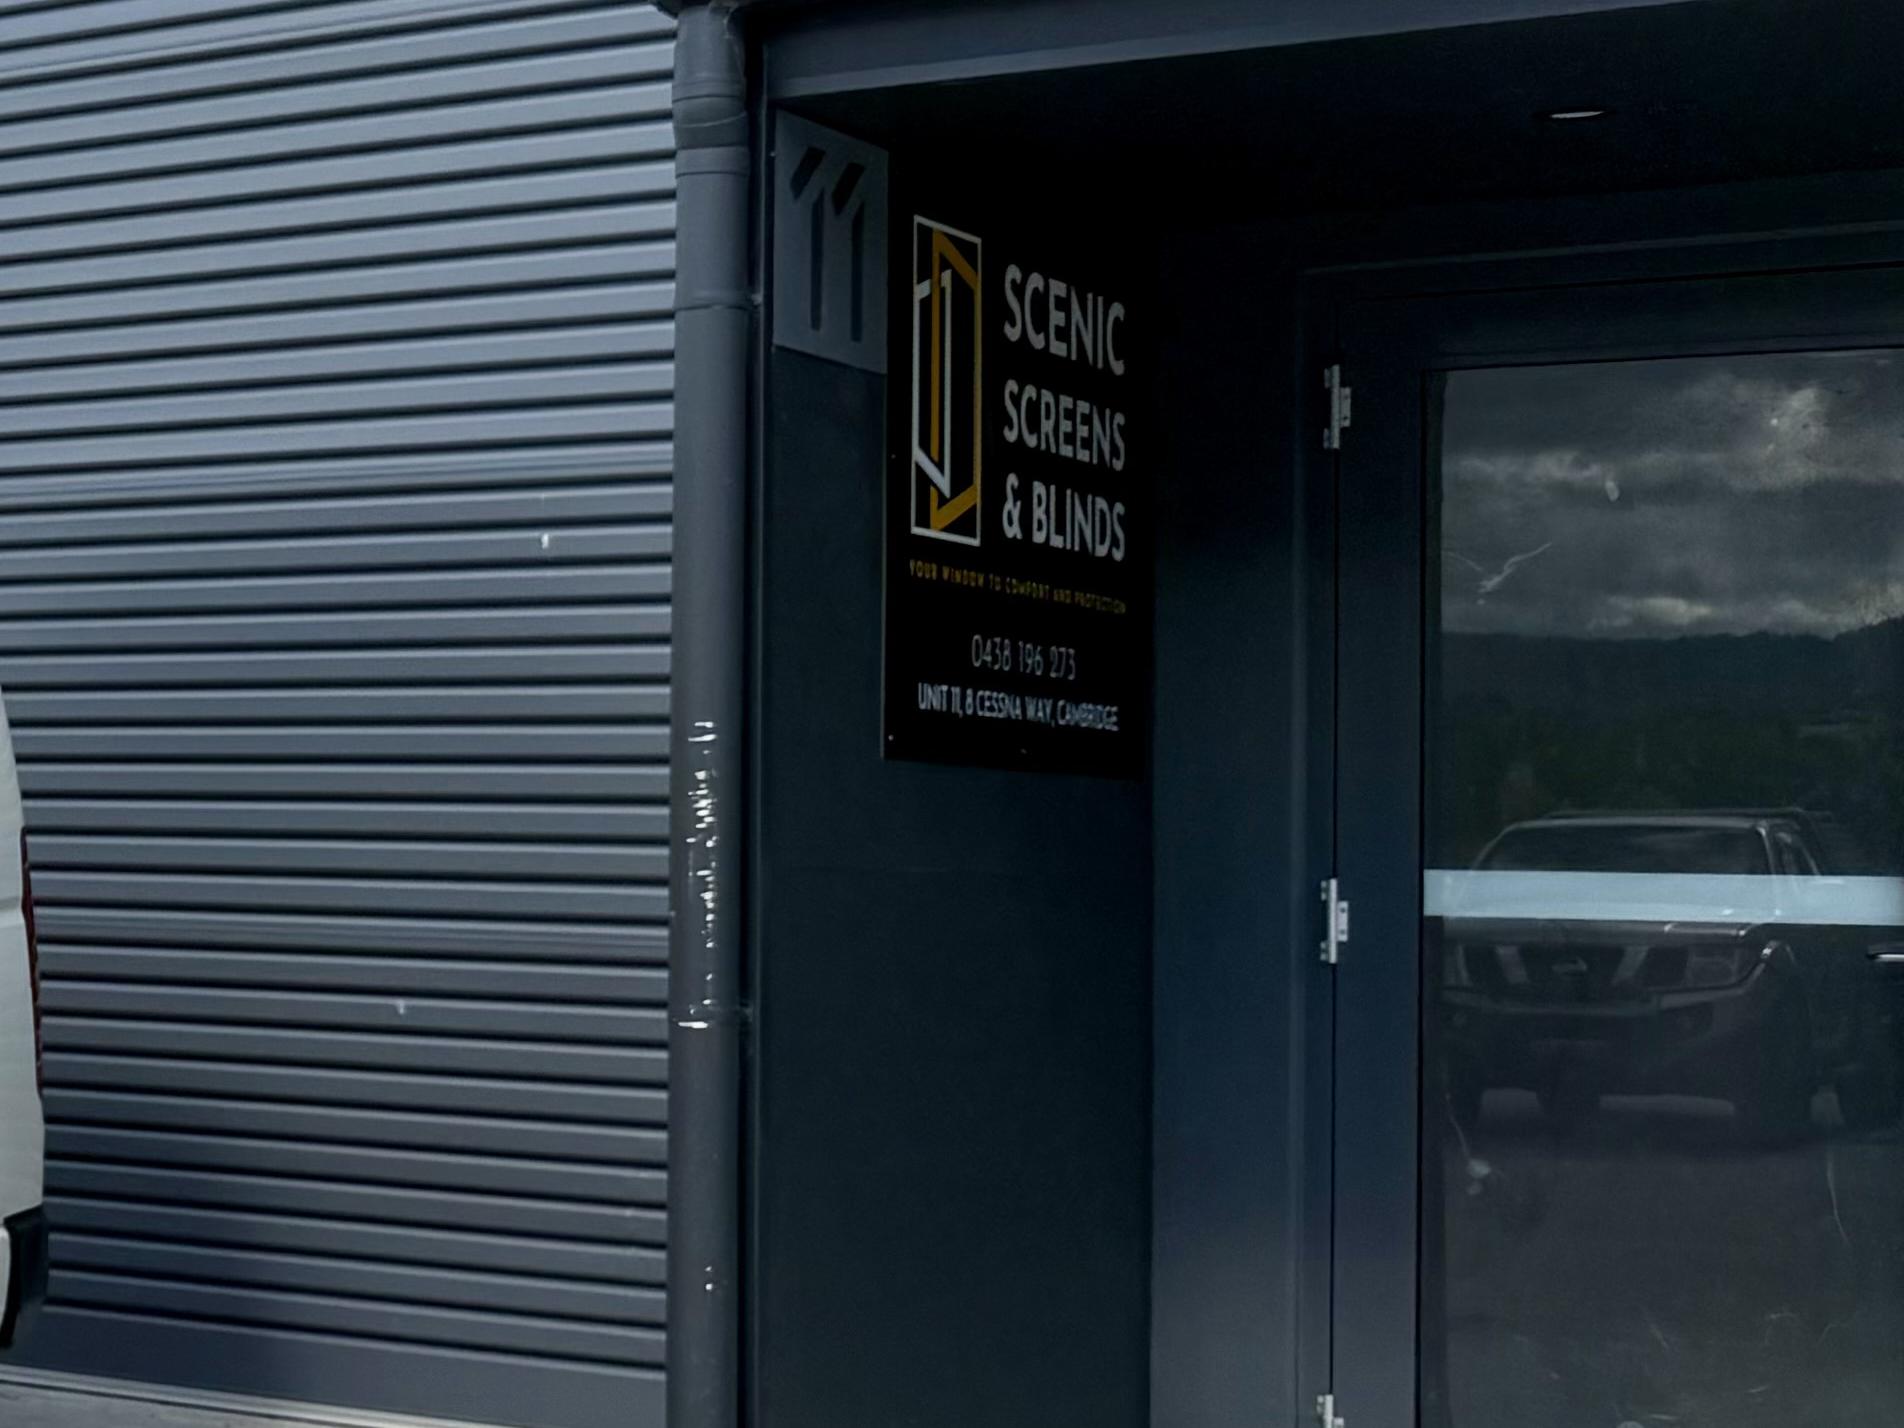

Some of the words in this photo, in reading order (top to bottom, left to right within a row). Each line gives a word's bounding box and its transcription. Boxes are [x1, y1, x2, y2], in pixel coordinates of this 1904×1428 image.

[1003, 263, 1125, 376] SCENIC
[1003, 378, 1125, 472] SCREENS
[1002, 472, 1023, 540] &
[1032, 480, 1125, 562] BLINDS
[971, 634, 1012, 672] 0438
[1018, 640, 1044, 676] 196
[1050, 645, 1076, 681] 273
[918, 682, 948, 712] UNIT
[965, 687, 974, 715] 8
[975, 690, 1023, 721] CESSNA
[1025, 696, 1055, 729] WAY,
